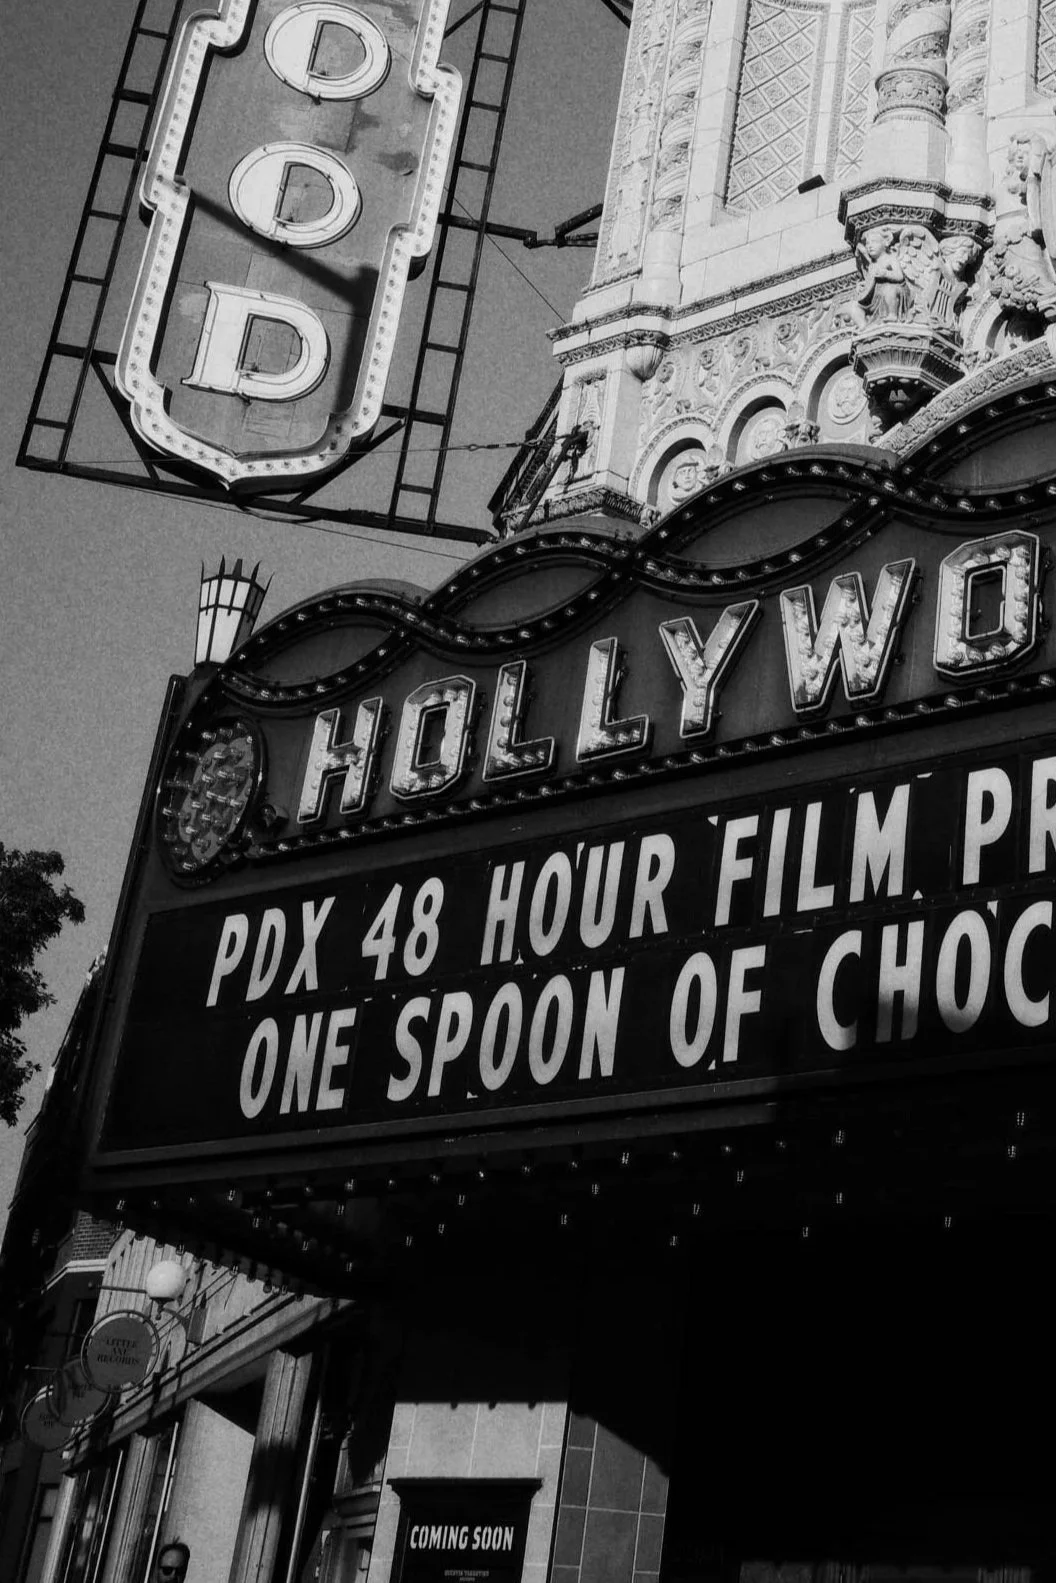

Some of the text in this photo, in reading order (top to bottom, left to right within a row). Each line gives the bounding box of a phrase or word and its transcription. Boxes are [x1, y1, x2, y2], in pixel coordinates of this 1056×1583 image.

[206, 896, 335, 1007] PDX
[361, 877, 444, 981] 48
[480, 832, 676, 967] HOUR
[713, 782, 910, 926] FILM
[239, 1007, 357, 1119] ONE
[386, 966, 625, 1103] SPOON
[669, 944, 767, 1068] OF
[410, 1525, 515, 1552] COMING SOON
